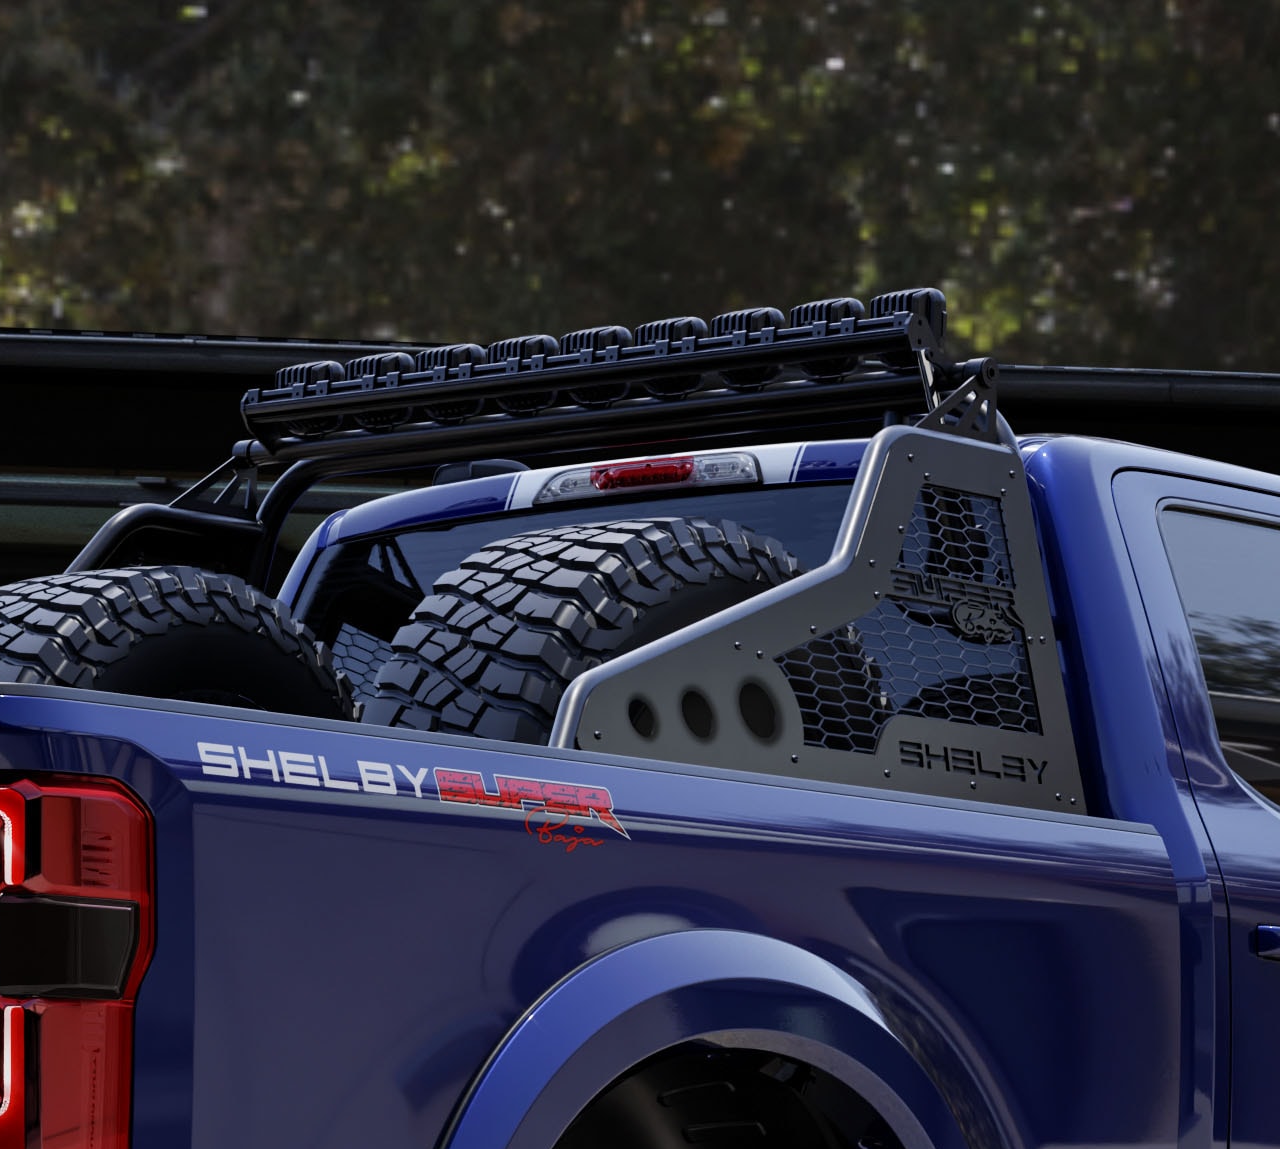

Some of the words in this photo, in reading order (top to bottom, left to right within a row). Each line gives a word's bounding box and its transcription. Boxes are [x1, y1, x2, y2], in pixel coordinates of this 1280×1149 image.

[898, 740, 1048, 785] SHELBY
[197, 741, 428, 798] SHELBY
[433, 766, 632, 840] SUPER
[524, 807, 605, 853] Baja
